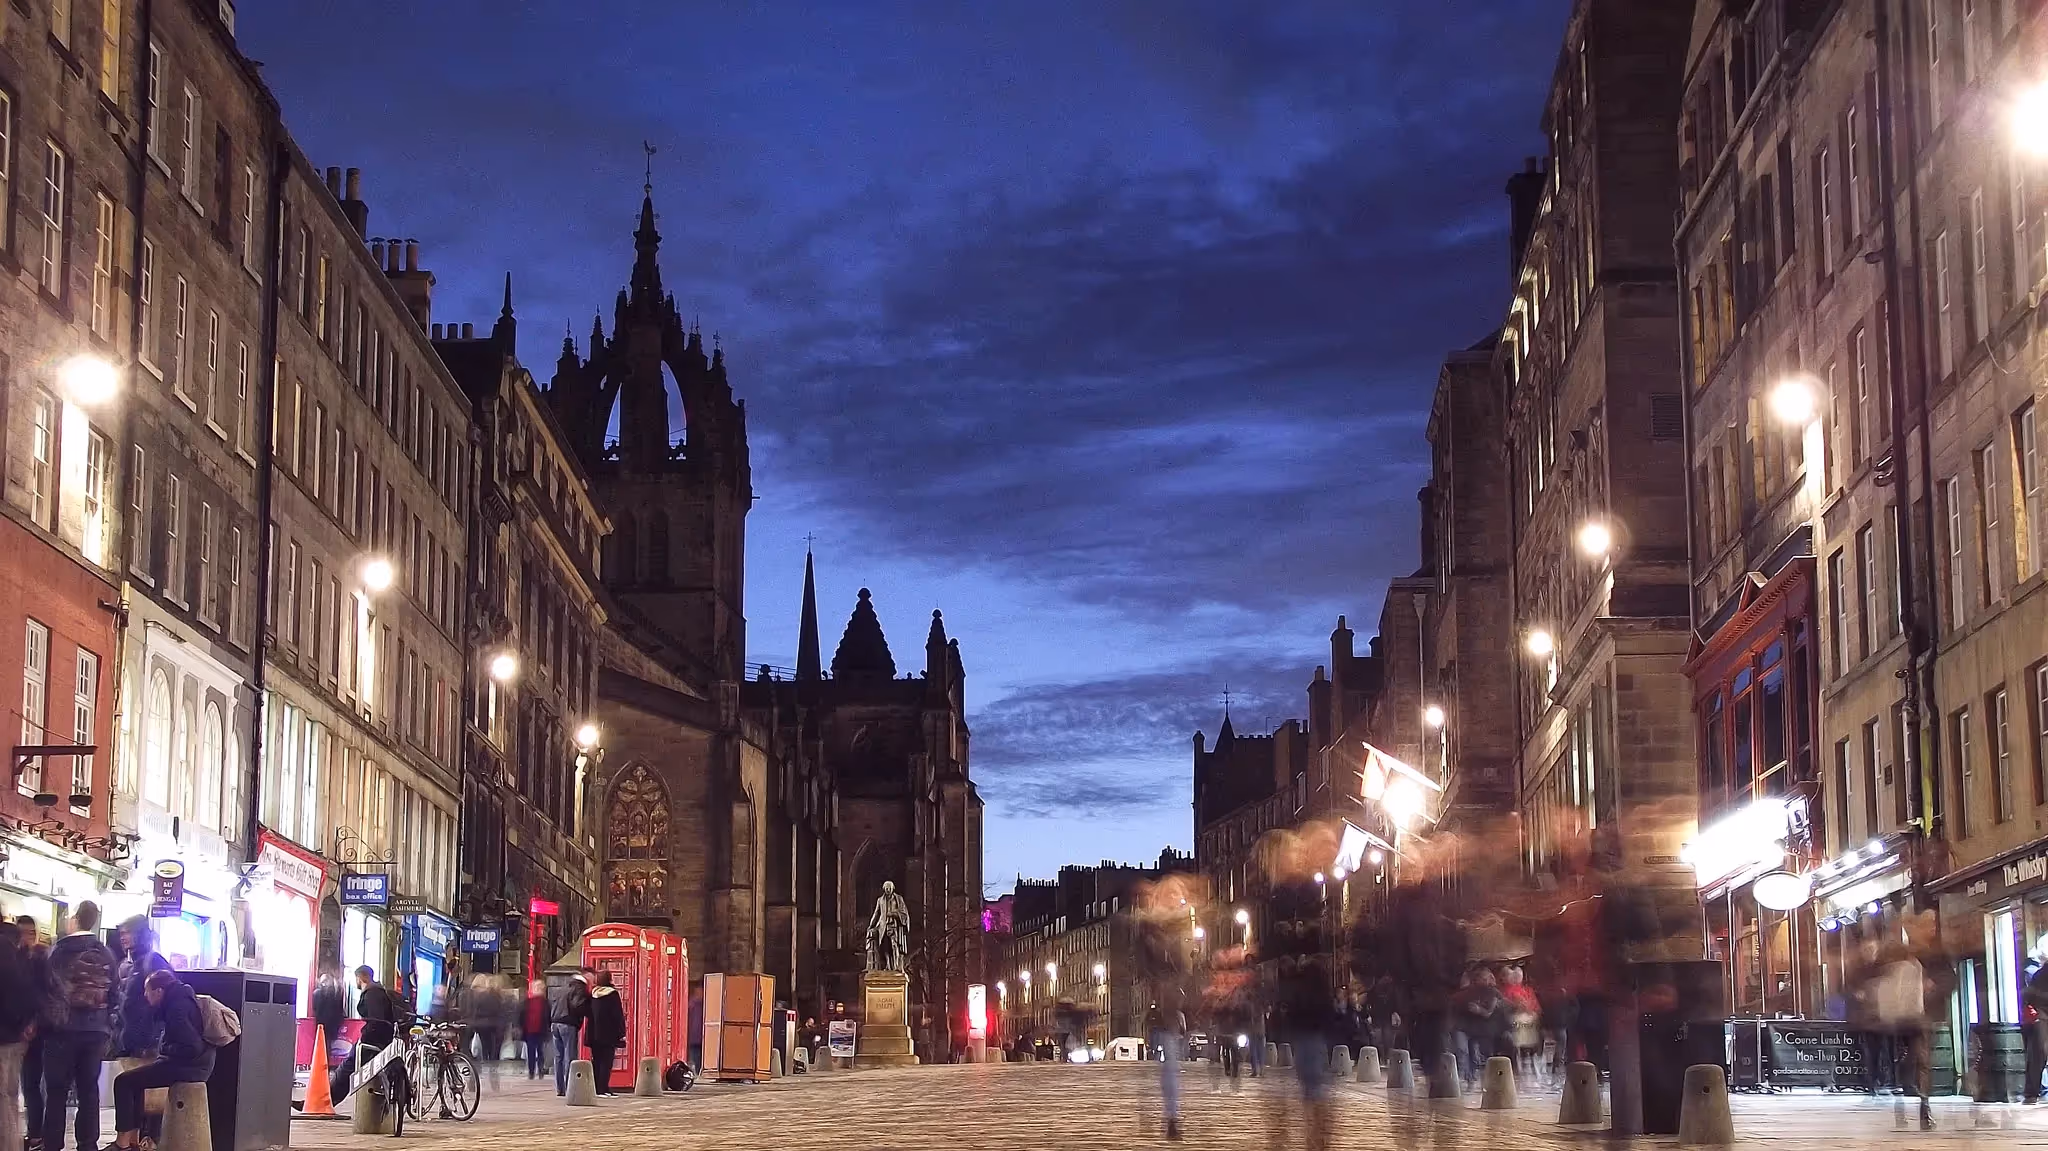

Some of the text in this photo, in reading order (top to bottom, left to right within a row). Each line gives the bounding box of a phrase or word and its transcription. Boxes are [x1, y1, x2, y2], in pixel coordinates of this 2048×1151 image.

[2002, 853, 2047, 887] The Whisky
[346, 876, 383, 892] fringe
[362, 892, 383, 900] office
[466, 929, 497, 942] fringe
[1773, 1032, 1783, 1045] 2
[1784, 1032, 1818, 1045] Course
[1820, 1032, 1841, 1045] Lunch
[1796, 1049, 1862, 1062] Mon-Thurs 12-5
[1834, 1066, 1852, 1075] 0131
